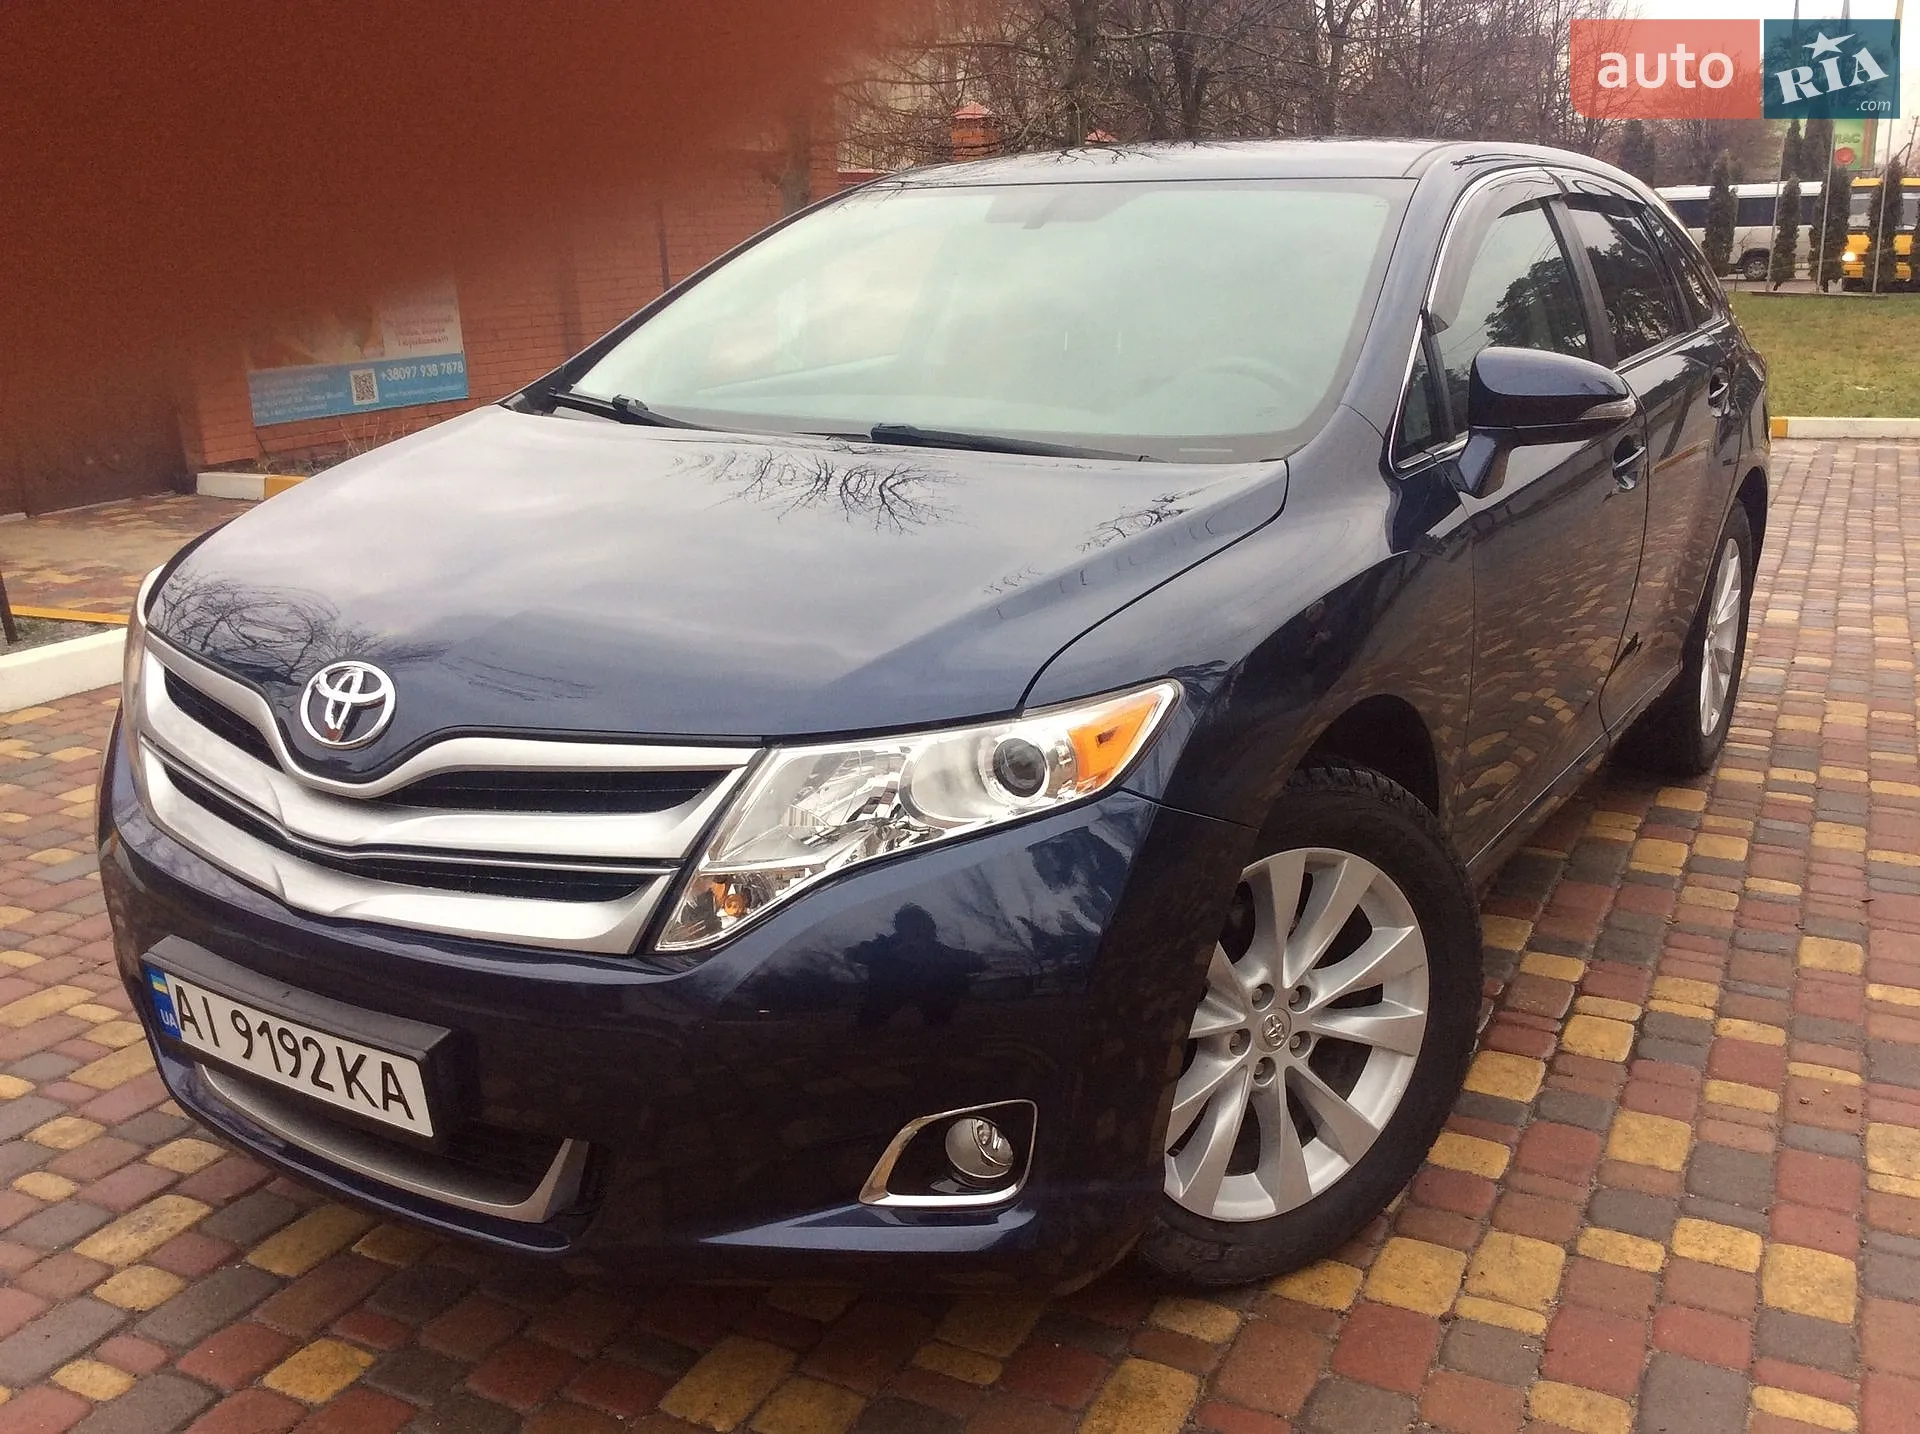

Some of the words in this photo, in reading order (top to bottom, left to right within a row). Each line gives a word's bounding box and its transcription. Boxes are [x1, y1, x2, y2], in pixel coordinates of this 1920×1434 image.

[160, 1009, 178, 1030] UA
[175, 983, 220, 1048] AI
[230, 1009, 335, 1093] 9192
[336, 1046, 415, 1121] KA
